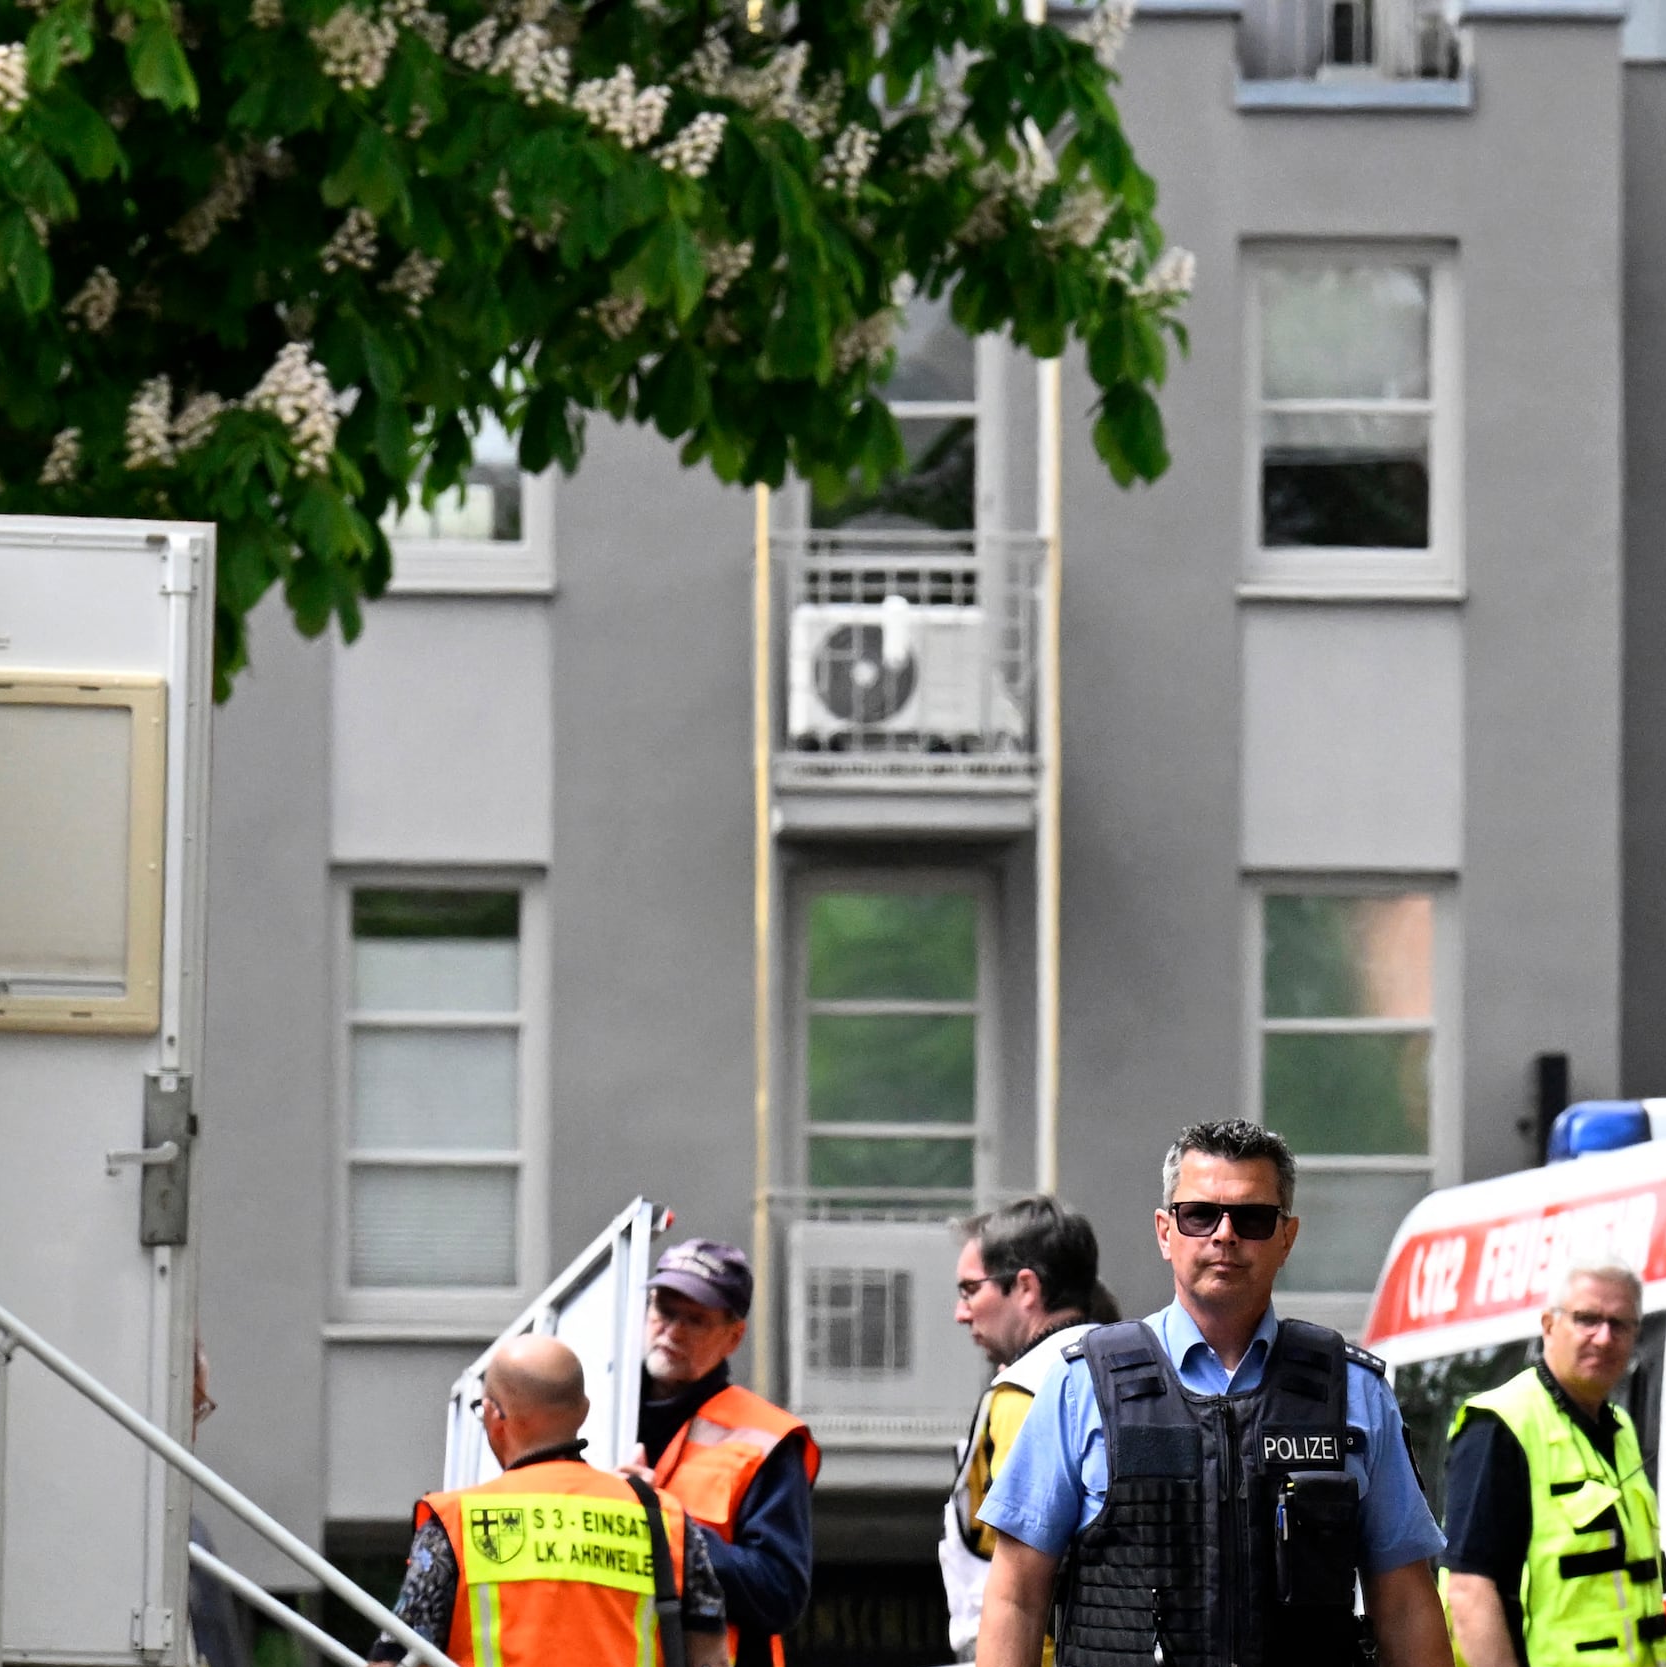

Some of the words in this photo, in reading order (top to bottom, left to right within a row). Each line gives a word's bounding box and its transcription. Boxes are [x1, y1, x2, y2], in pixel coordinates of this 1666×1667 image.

[1422, 1236, 1467, 1317] 112
[1263, 1436, 1339, 1460] POLIZEI
[533, 1508, 545, 1529] S
[553, 1508, 564, 1529] 3
